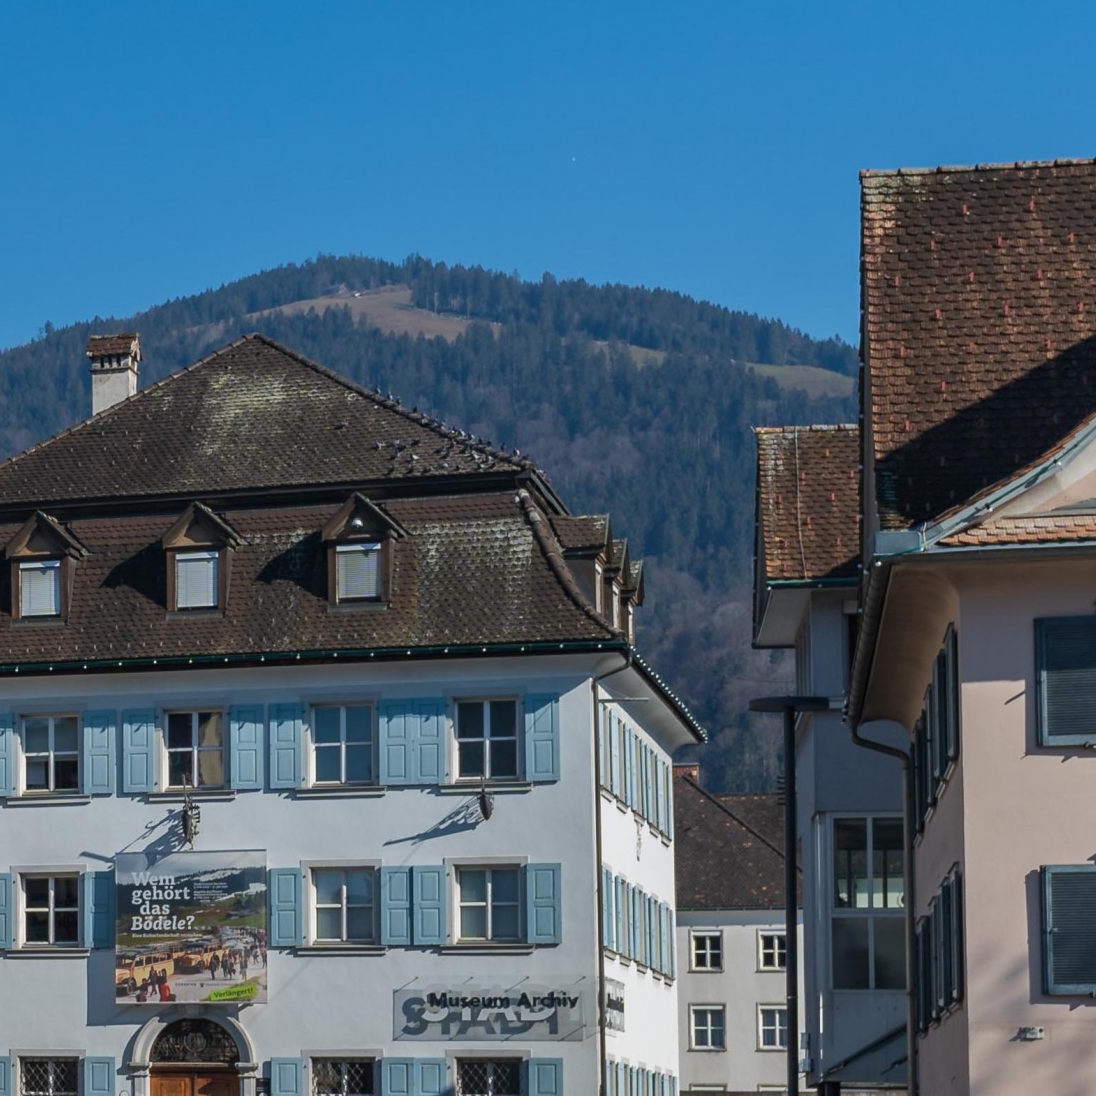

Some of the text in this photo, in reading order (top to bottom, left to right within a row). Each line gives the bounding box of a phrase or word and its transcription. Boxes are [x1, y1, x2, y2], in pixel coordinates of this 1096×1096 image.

[131, 872, 176, 886] Wem
[131, 886, 190, 905] gehört
[139, 901, 170, 915] das
[130, 915, 195, 931] Bödele?
[426, 990, 579, 1009] Museum Archiv
[402, 996, 559, 1035] STADT
